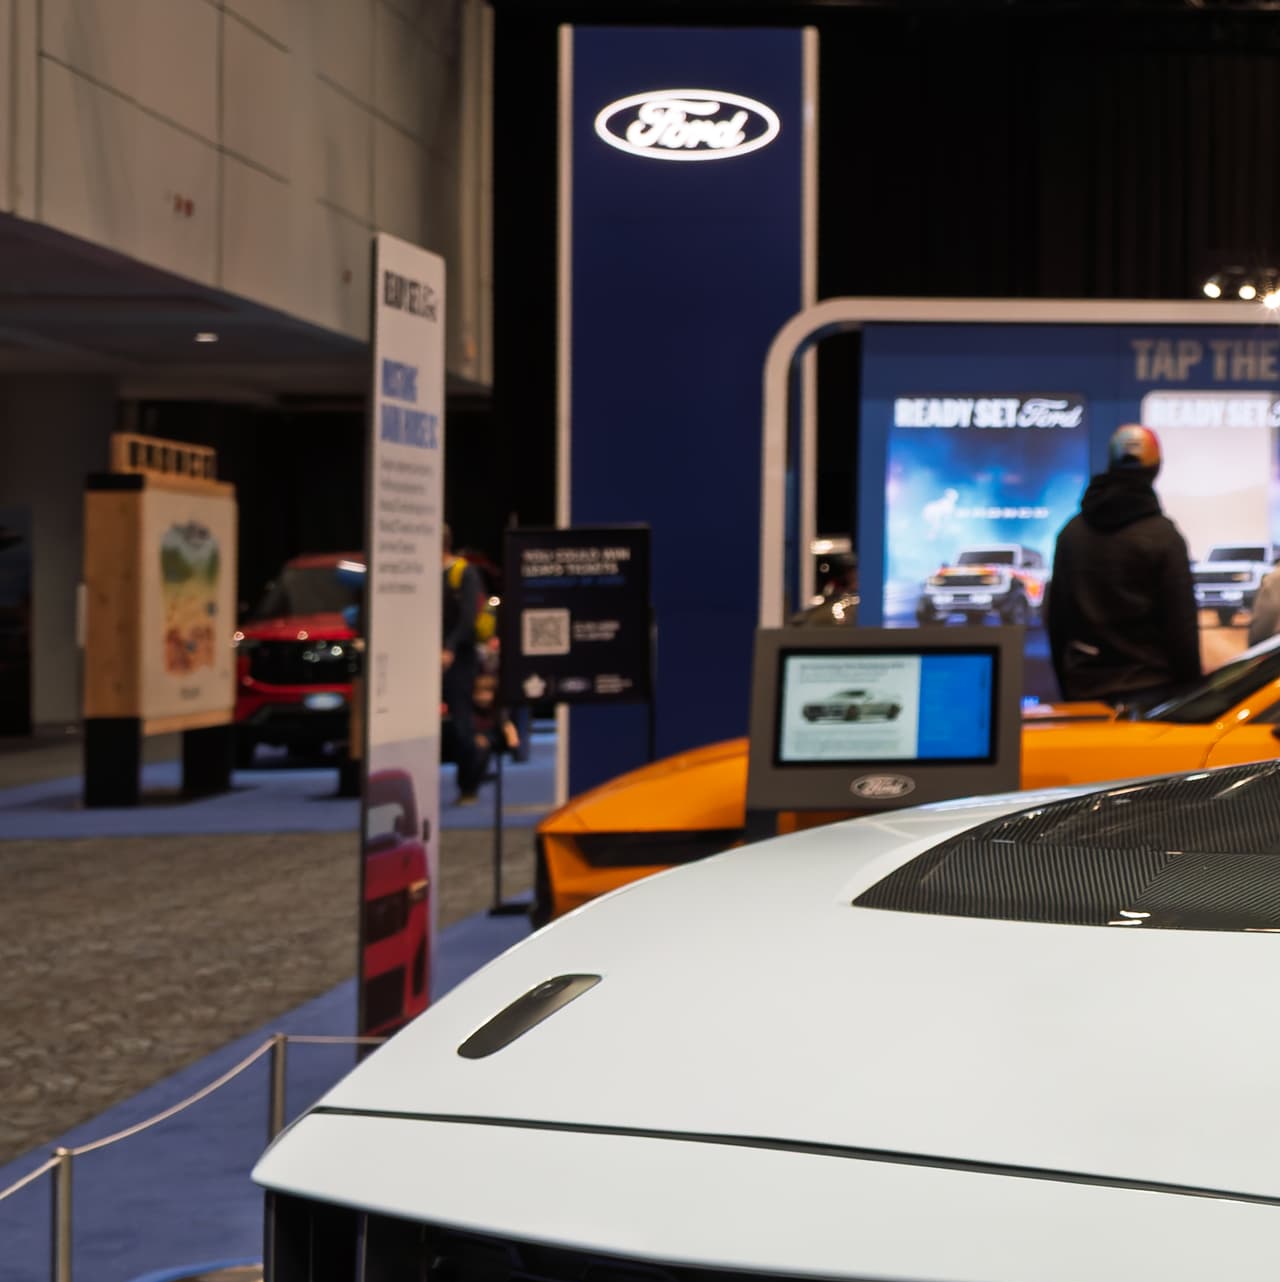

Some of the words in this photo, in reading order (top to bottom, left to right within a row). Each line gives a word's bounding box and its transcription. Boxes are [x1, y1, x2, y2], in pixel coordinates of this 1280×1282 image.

[626, 99, 748, 148] Ford
[1132, 340, 1201, 381] TAP
[1211, 340, 1280, 381] THE
[895, 399, 974, 427] READY
[974, 399, 1019, 428] SET
[1018, 399, 1083, 428] Ford
[1225, 399, 1269, 428] SET
